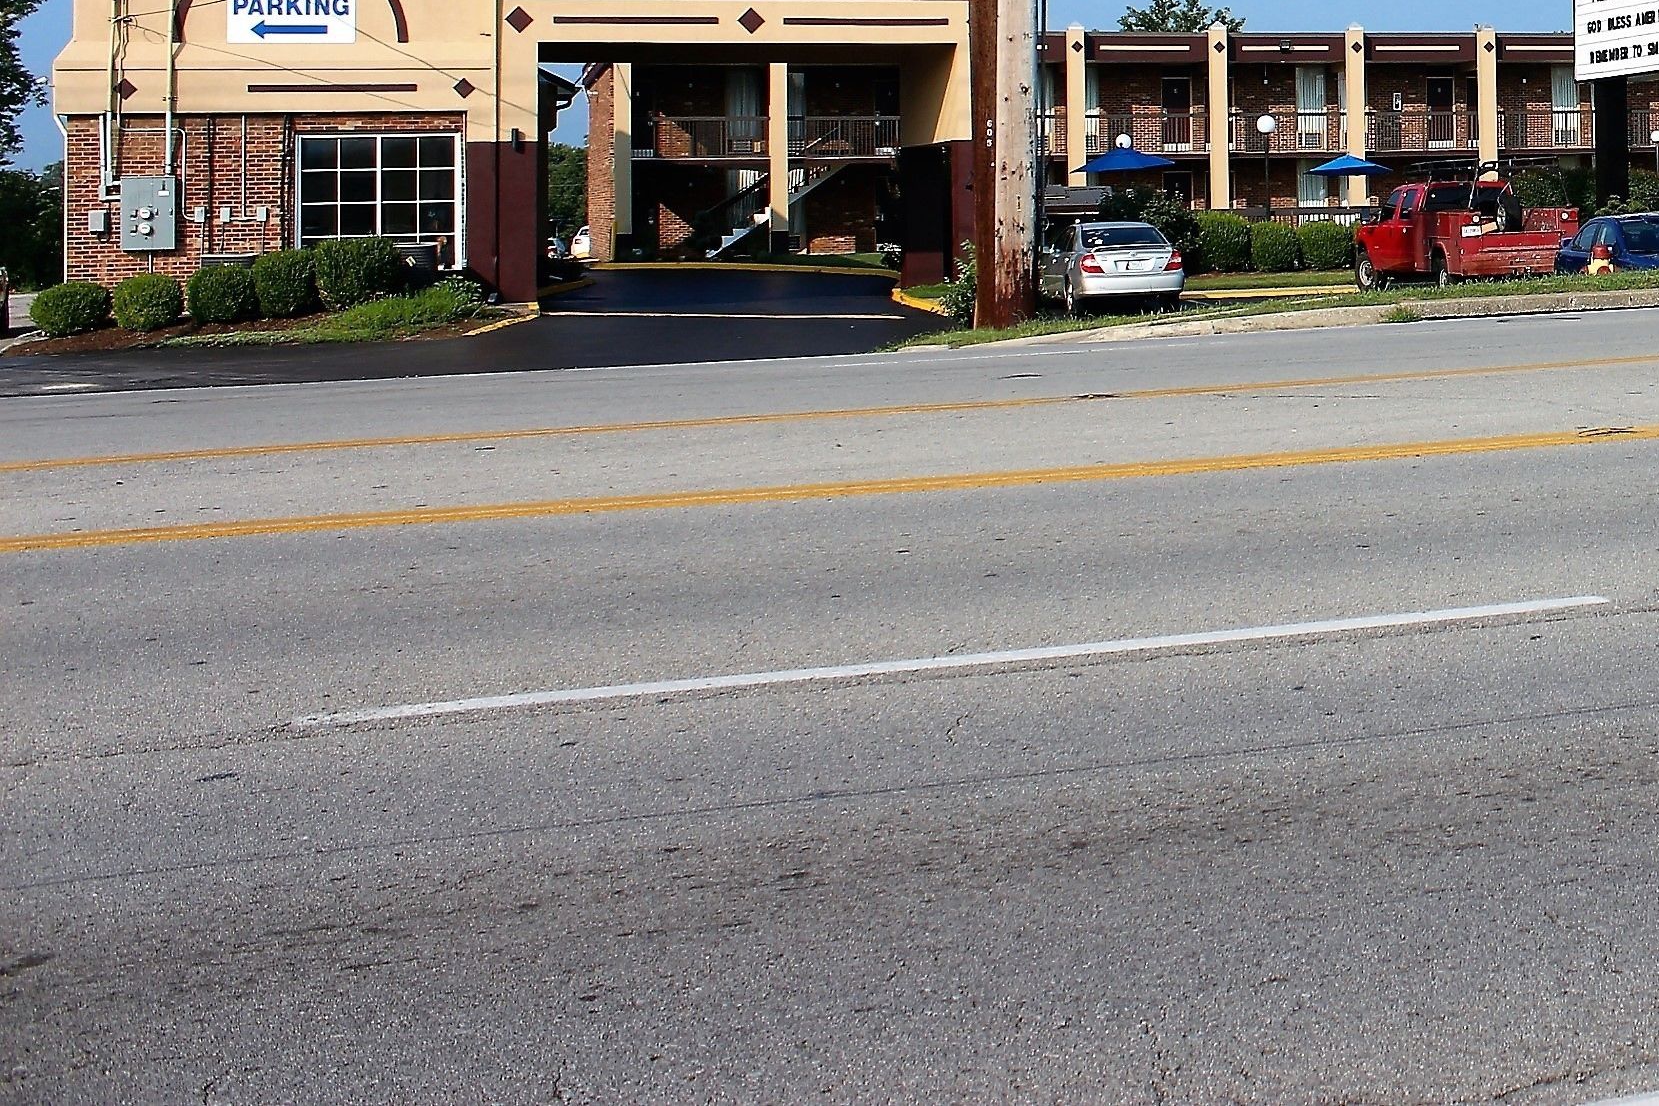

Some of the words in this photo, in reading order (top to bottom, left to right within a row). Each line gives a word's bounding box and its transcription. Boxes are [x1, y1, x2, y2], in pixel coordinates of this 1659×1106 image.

[1587, 19, 1602, 34] GOD
[1607, 14, 1632, 31] BLESS
[1589, 46, 1629, 64] REMEMBER
[1632, 44, 1643, 58] TO
